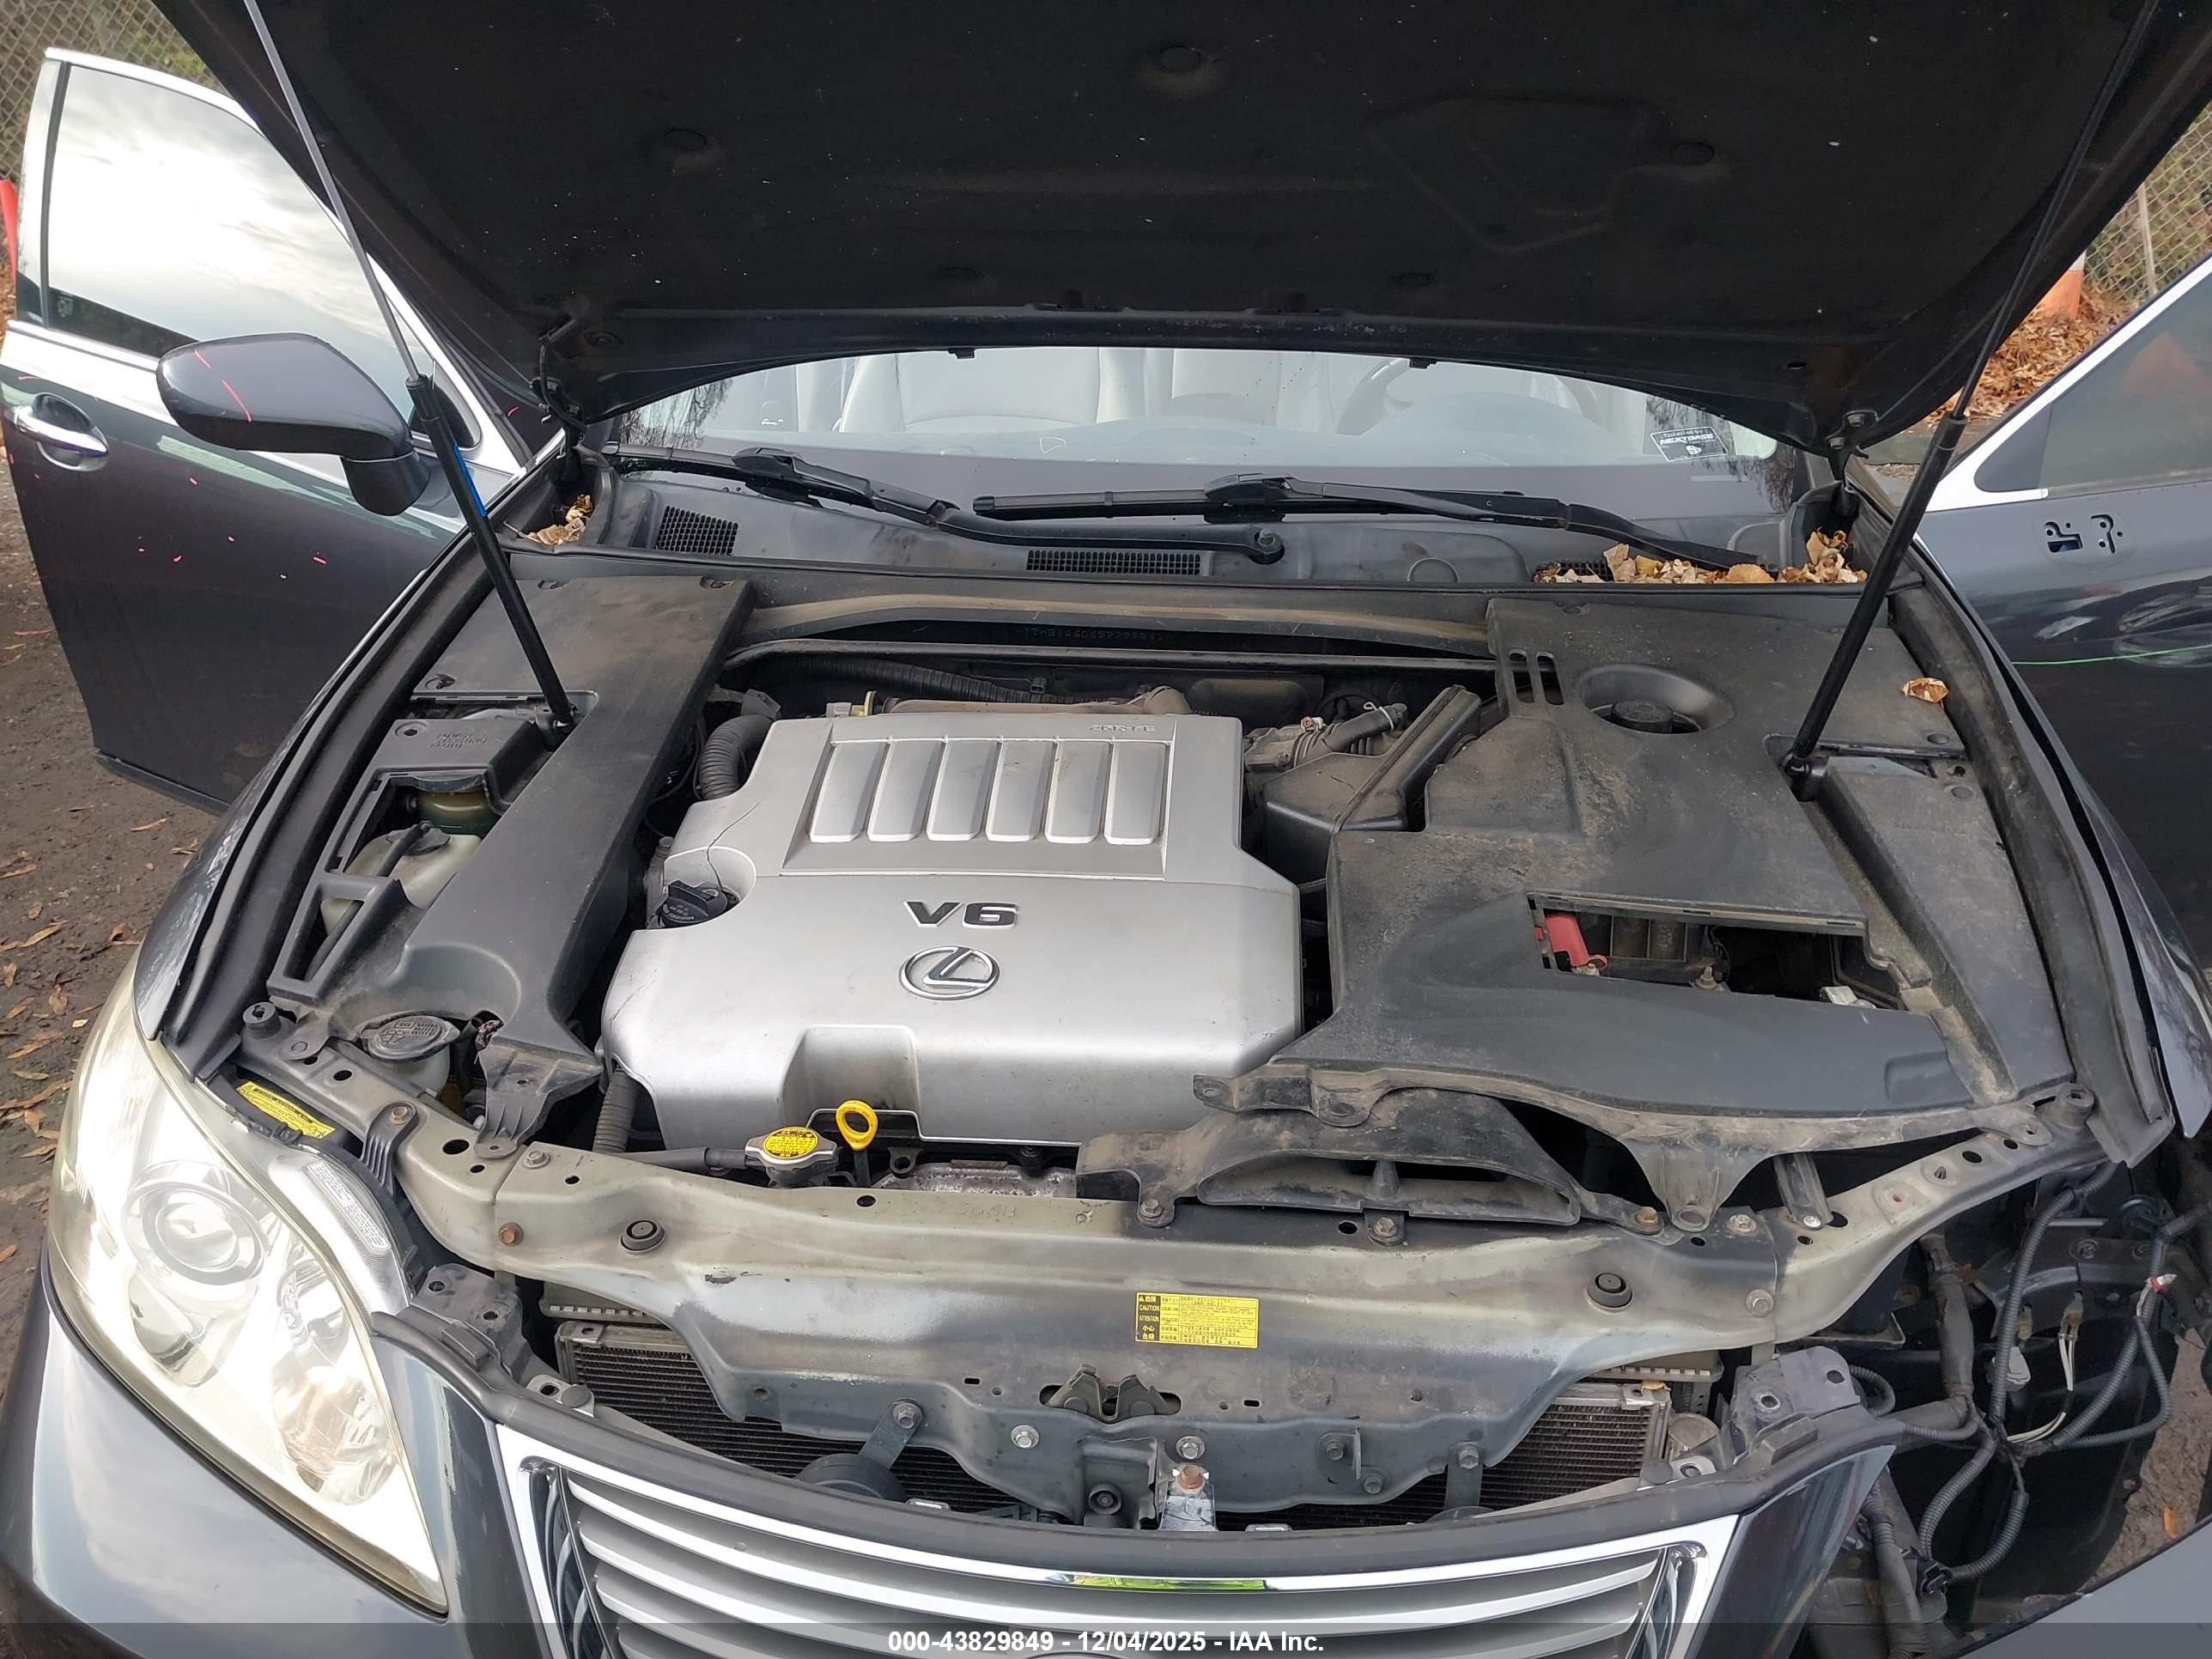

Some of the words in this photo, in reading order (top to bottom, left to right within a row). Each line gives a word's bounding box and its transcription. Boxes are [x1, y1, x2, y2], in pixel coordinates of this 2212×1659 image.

[902, 900, 1018, 929] V6
[1139, 1304, 1160, 1312] CAUTION
[1139, 1314, 1160, 1323] ATTENTION
